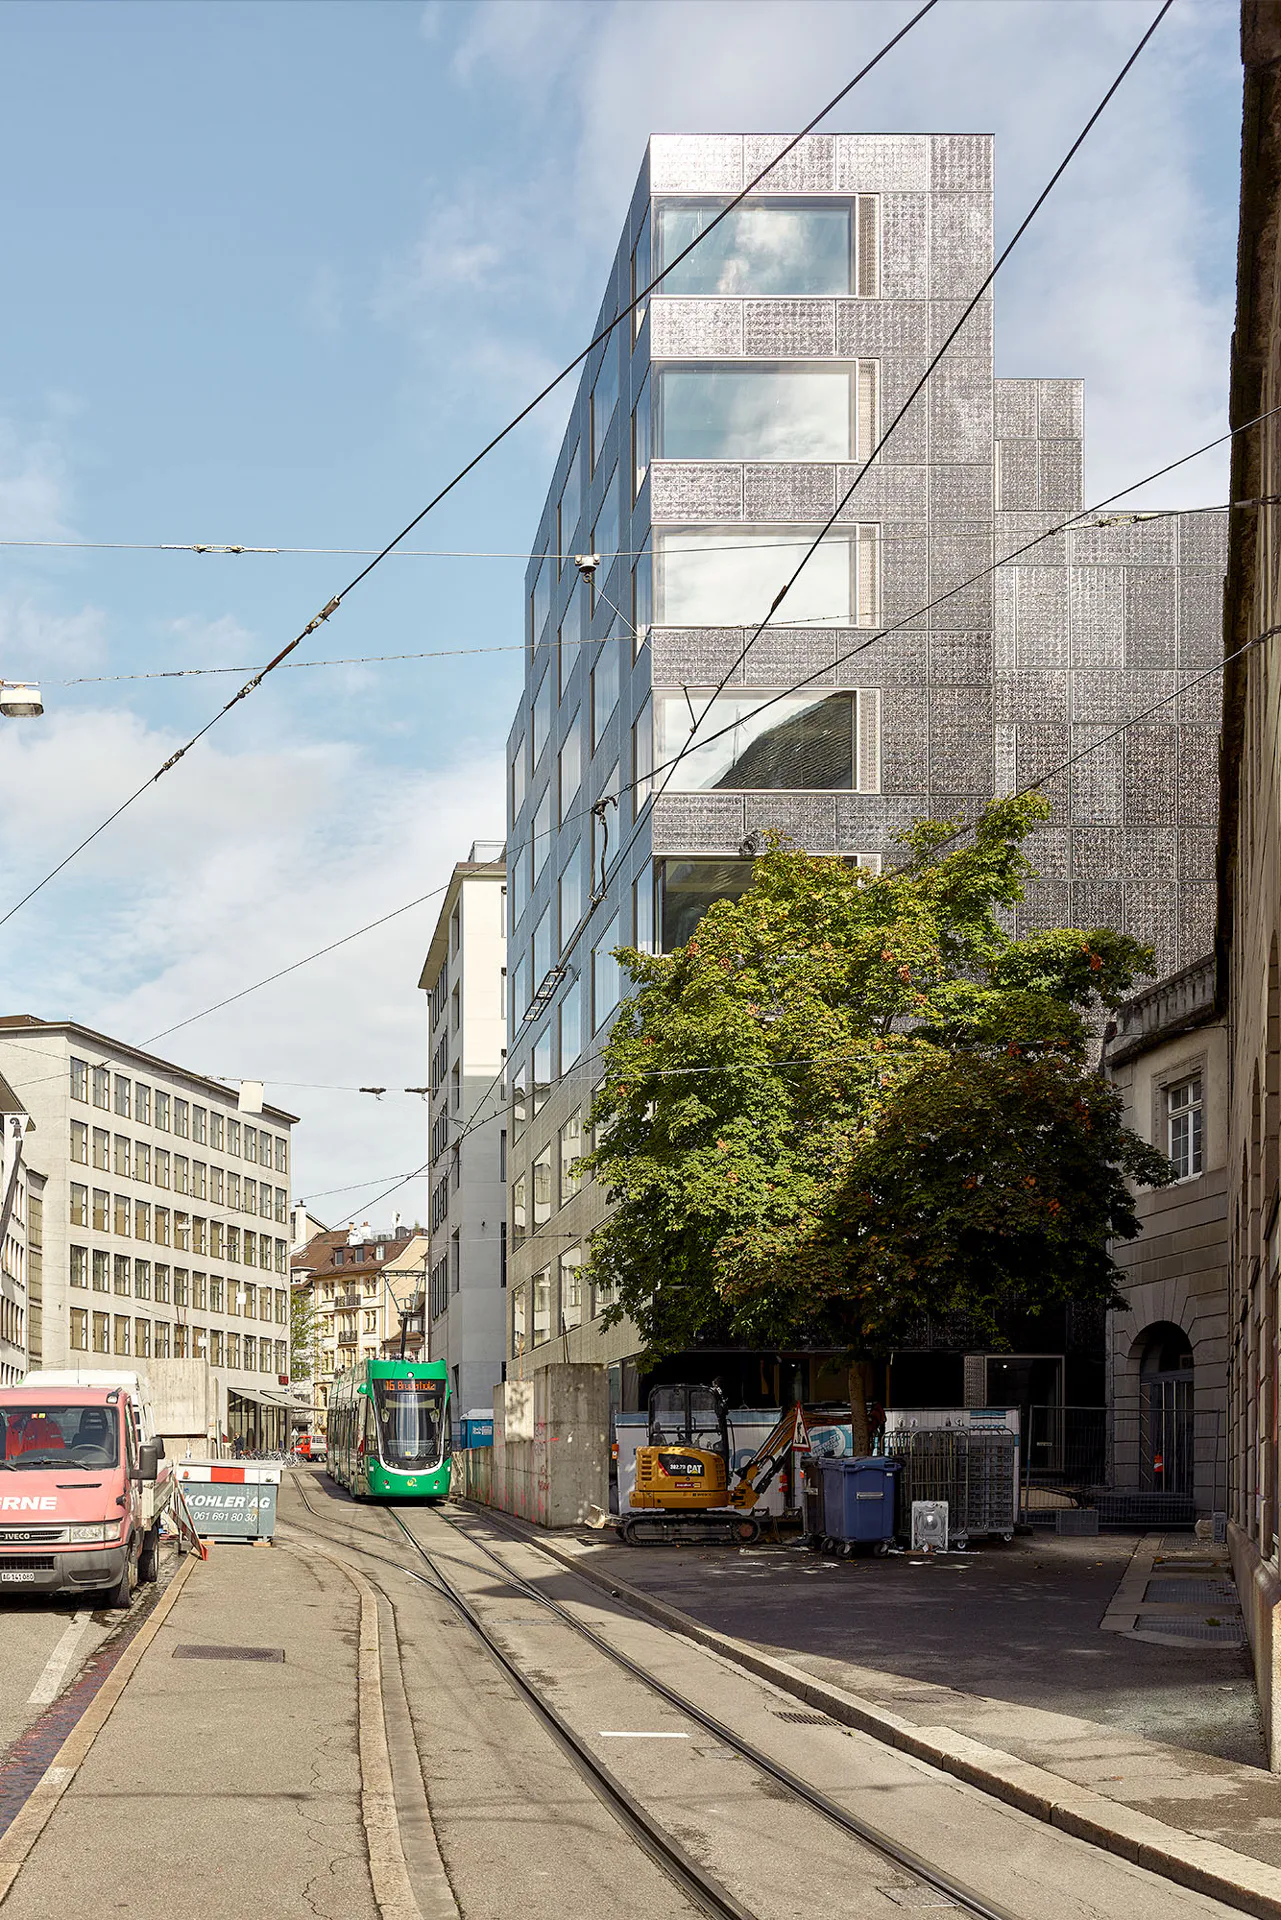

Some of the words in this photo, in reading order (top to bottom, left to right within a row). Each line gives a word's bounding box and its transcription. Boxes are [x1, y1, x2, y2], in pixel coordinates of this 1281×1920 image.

[386, 1380, 395, 1391] 16
[398, 1380, 436, 1391] Bruholz
[687, 1464, 702, 1474] CAT
[0, 1497, 57, 1510] RNE
[184, 1495, 246, 1508] KOHLER
[248, 1496, 271, 1509] AG
[193, 1511, 210, 1520] 061
[212, 1512, 228, 1521] 691
[230, 1512, 243, 1522] 80
[244, 1513, 257, 1522] 30
